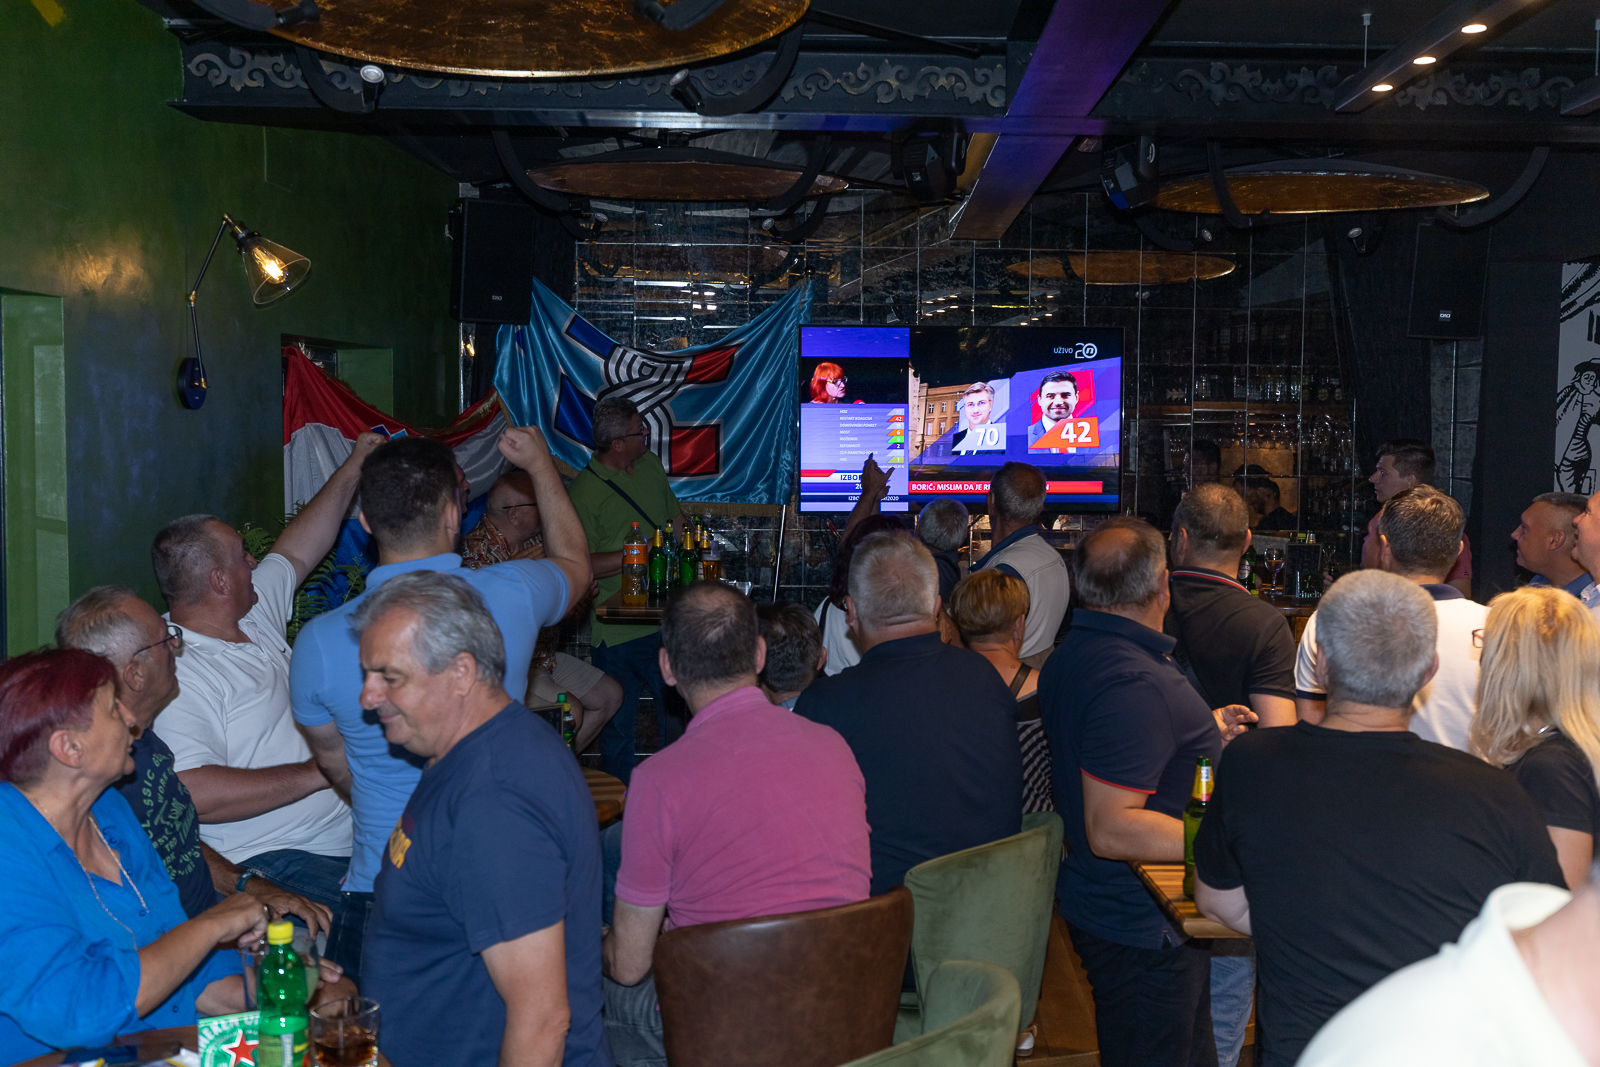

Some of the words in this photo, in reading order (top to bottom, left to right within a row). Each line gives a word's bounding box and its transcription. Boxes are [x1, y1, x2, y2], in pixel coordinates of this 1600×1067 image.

[1053, 346, 1073, 354] UŽIVO
[975, 427, 999, 446] 70
[1060, 421, 1092, 443] 42
[911, 482, 936, 491] BORIĆ:
[937, 483, 962, 491] MISLIM
[963, 483, 974, 491] DA
[974, 483, 983, 491] JE
